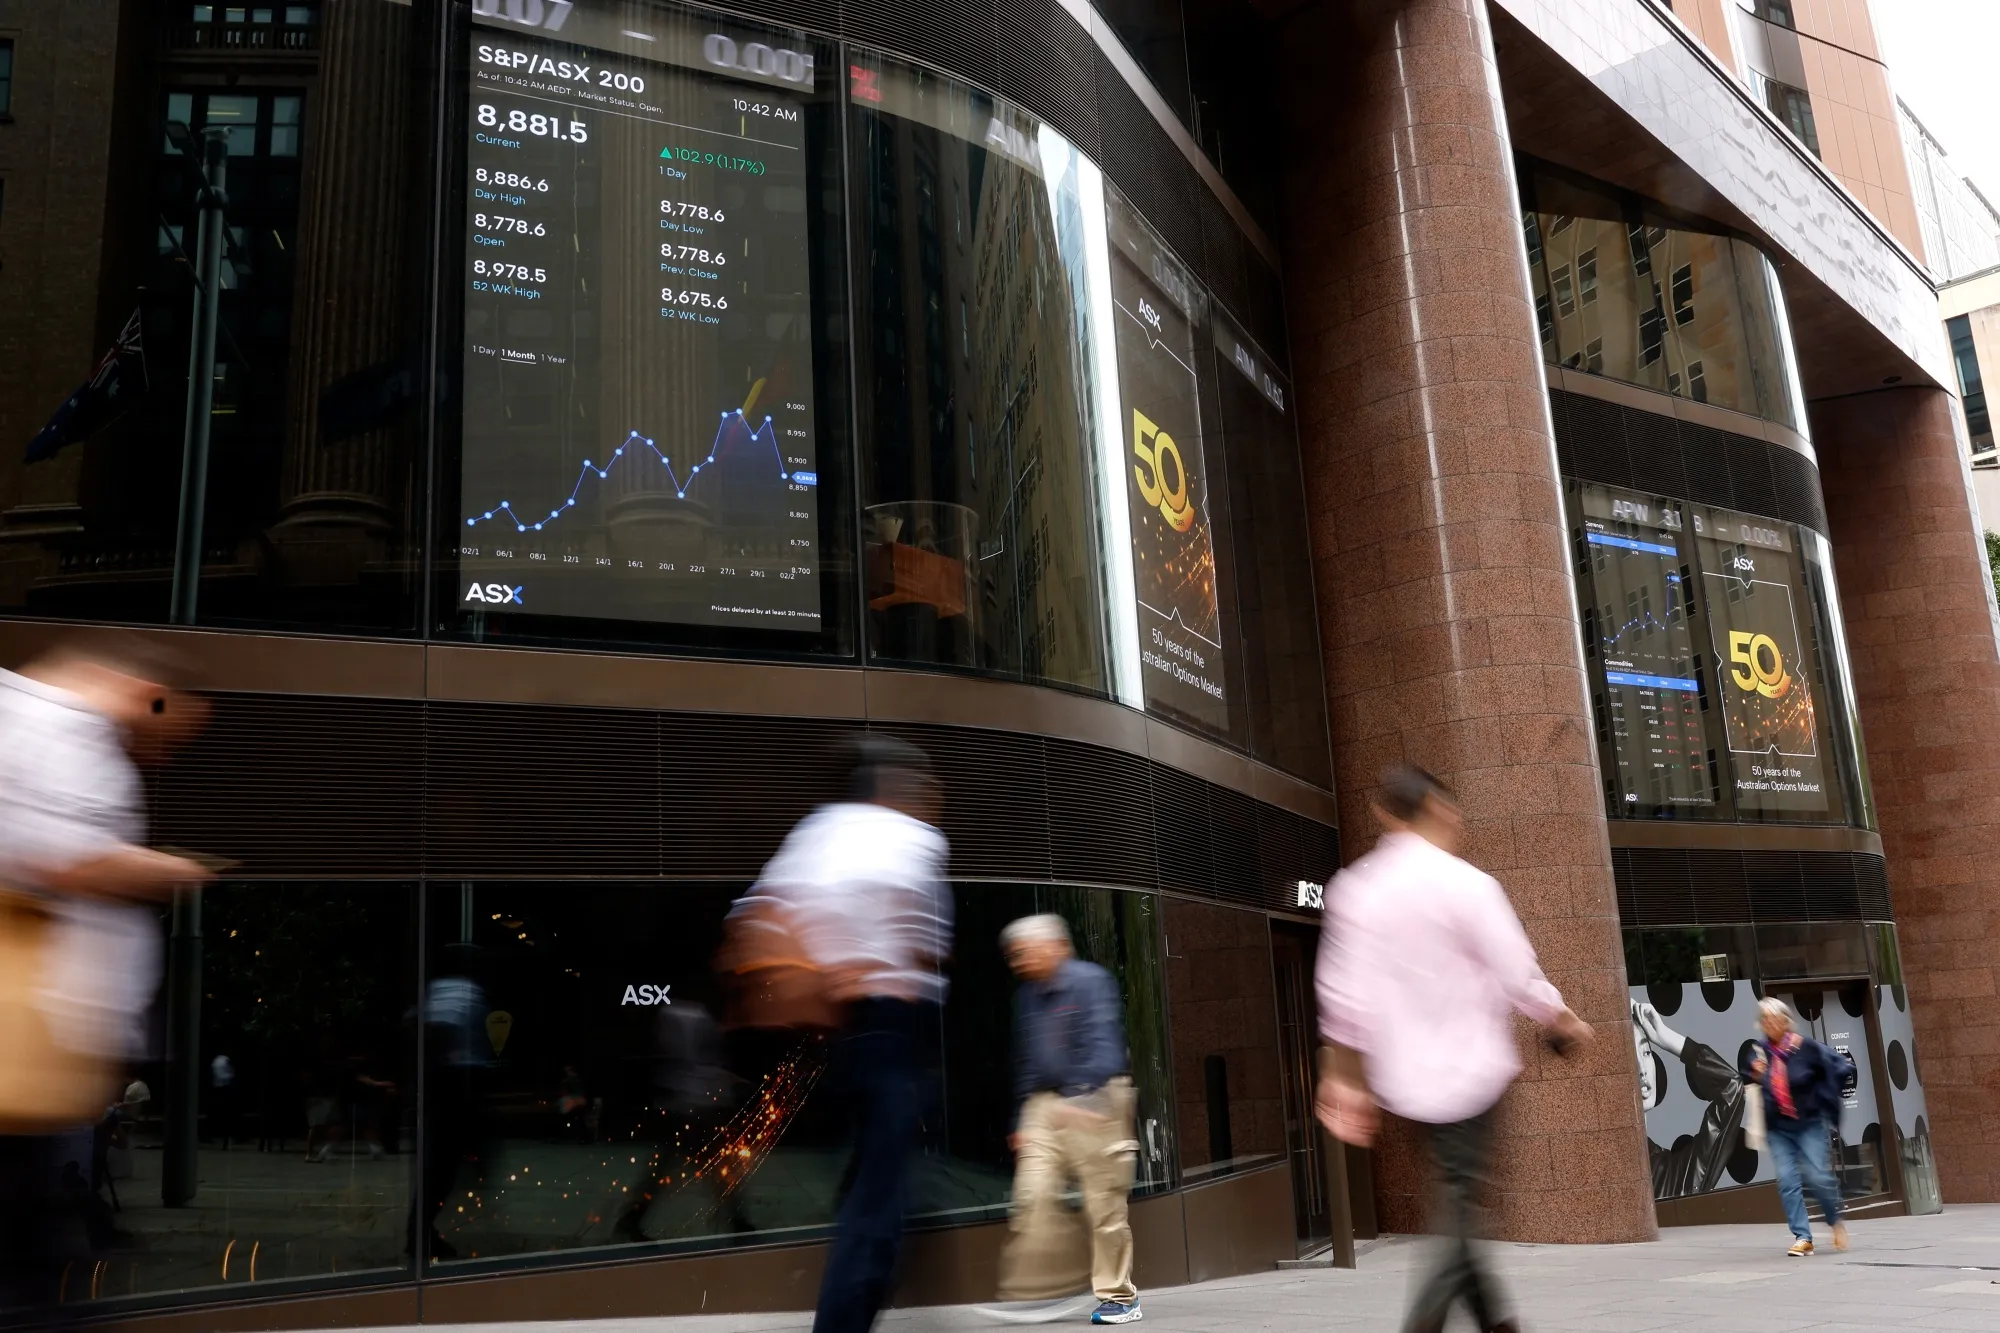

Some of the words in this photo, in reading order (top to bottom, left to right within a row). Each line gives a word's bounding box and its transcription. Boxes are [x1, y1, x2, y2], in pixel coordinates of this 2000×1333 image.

[478, 45, 590, 83] S&P/ASX
[599, 70, 644, 93] 200
[477, 71, 488, 79] As
[504, 75, 528, 87] 10:42
[530, 81, 545, 90] AM
[547, 84, 571, 95] AEDT
[578, 91, 607, 103] Market
[609, 97, 637, 108] Status:
[639, 102, 664, 114] Open.
[733, 98, 770, 116] 10:42
[774, 107, 797, 122] AM
[477, 104, 588, 143] 8,881.5
[476, 133, 521, 149] Current
[659, 166, 664, 175] 1
[667, 168, 687, 181] Day
[717, 154, 766, 176] (1.17%)
[475, 168, 549, 192] 8,886.6
[475, 188, 497, 201] Day
[500, 193, 526, 206] High
[660, 200, 725, 222] 8,778.6
[474, 213, 546, 237] 8,778.6
[660, 219, 680, 232] Day
[683, 223, 704, 235] Low
[473, 234, 505, 247] Open
[660, 243, 726, 266] 8,778.6
[473, 260, 547, 283] 8,978.5
[660, 263, 686, 275] Prev.
[688, 268, 718, 280] Close
[473, 281, 488, 291] 52
[491, 284, 512, 295] WK
[514, 287, 541, 300] High
[661, 288, 728, 310] 8,675.6
[661, 308, 675, 318] 52
[678, 311, 696, 321] WK
[699, 314, 720, 325] Low
[1139, 298, 1162, 333] ASX
[473, 345, 476, 353] 1
[478, 346, 496, 356] Day
[501, 349, 506, 357] 1
[507, 350, 536, 360] Month
[546, 355, 567, 364] Year
[1133, 408, 1187, 512] 50
[462, 547, 480, 556] 02/1
[496, 550, 513, 559] 06/1
[529, 552, 547, 561] 08/1
[563, 555, 579, 564] 12/1
[595, 557, 612, 566] 14/1
[627, 560, 644, 569] 16/1
[658, 562, 675, 571] 20/1
[689, 565, 705, 573] 22/1
[720, 567, 736, 576] 27/1
[750, 569, 766, 578] 29/1
[779, 572, 795, 580] 02/2
[1733, 557, 1755, 571] ASX
[465, 582, 523, 605] ASX
[731, 606, 755, 615] delayed
[755, 608, 764, 616] by
[772, 609, 787, 617] least
[796, 611, 821, 619] minutes
[1152, 628, 1163, 646] 50
[1164, 638, 1184, 657] years
[1184, 648, 1192, 662] of
[1193, 652, 1205, 669] the
[1729, 630, 1783, 692] 50
[1142, 651, 1172, 674] ustralian
[1172, 662, 1200, 688] Options
[1200, 676, 1223, 699] Market
[1752, 765, 1762, 776] 50
[1763, 768, 1781, 778] years
[1782, 767, 1789, 777] of
[1790, 767, 1802, 778] the
[1737, 779, 1770, 790] Australian
[1770, 780, 1797, 792] Options
[1797, 782, 1820, 793] Market
[1625, 793, 1639, 802] ASX
[1298, 880, 1325, 910] ASX
[621, 984, 671, 1006] ASX
[1830, 1032, 1850, 1040] CONTACT
